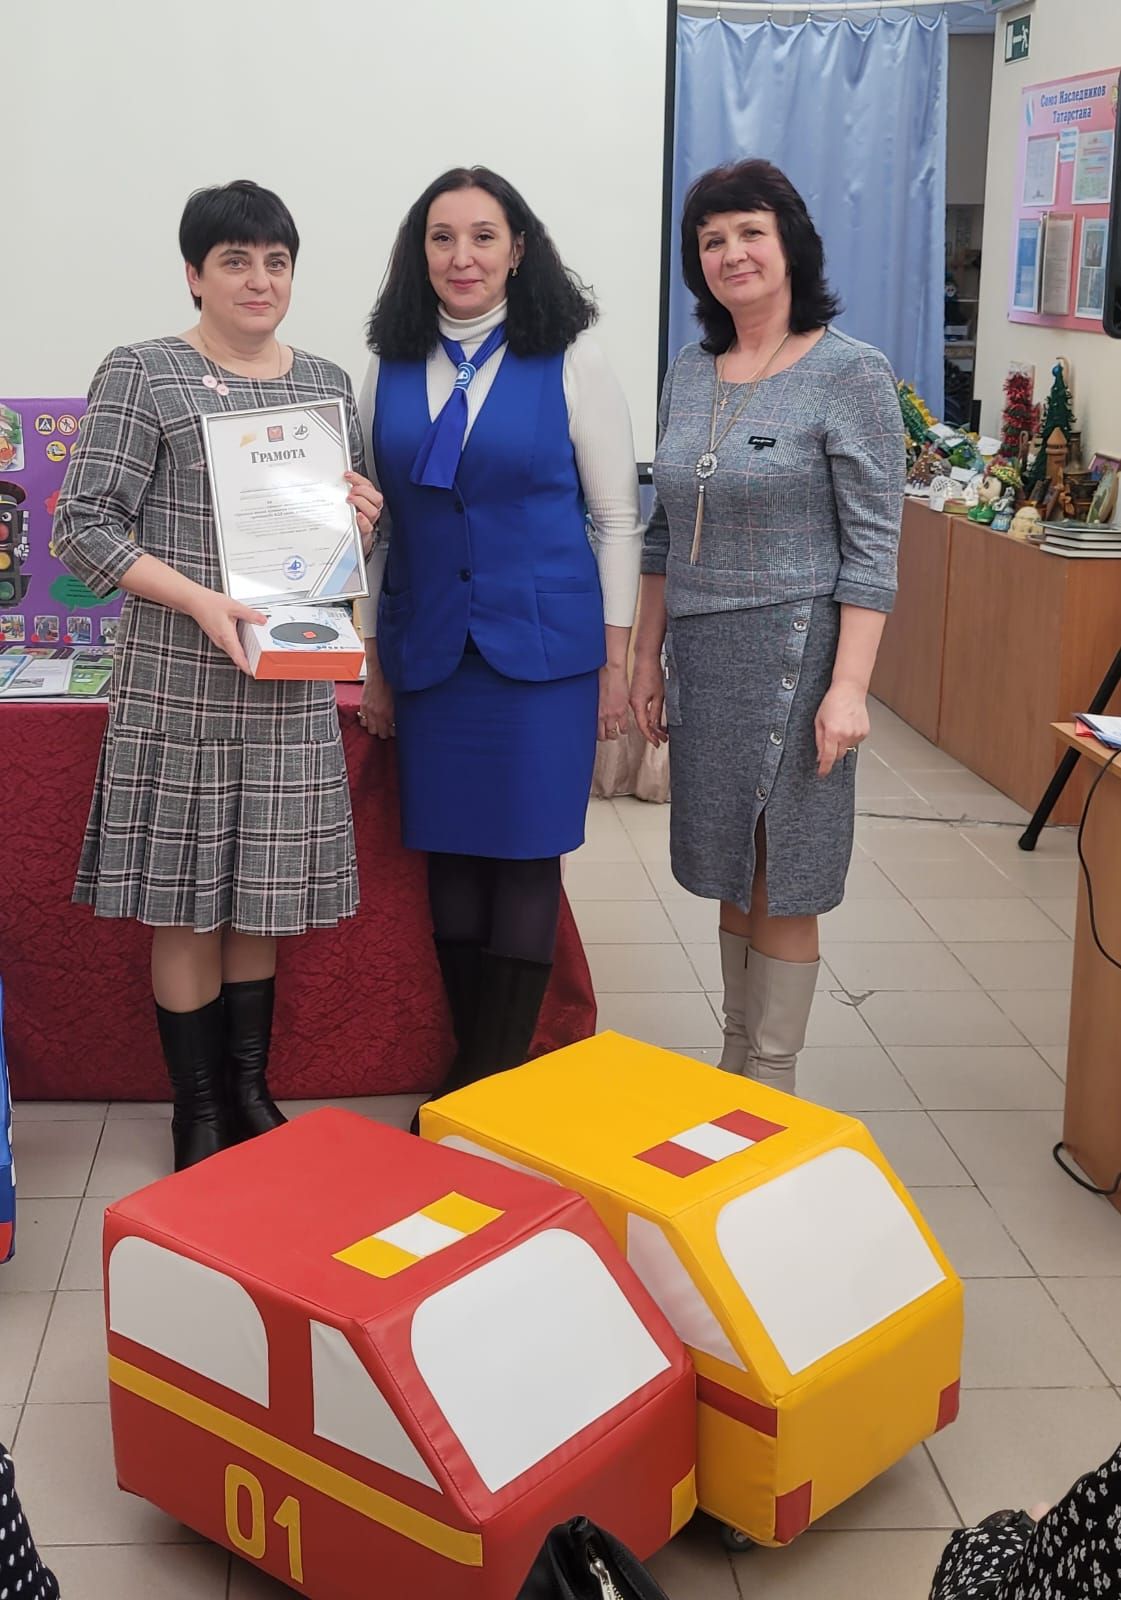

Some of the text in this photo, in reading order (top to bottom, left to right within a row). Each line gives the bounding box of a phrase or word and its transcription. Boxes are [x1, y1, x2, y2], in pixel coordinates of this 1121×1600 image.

[1041, 85, 1106, 107] Союз Наследников
[1053, 107, 1091, 124] Татарстана
[224, 1463, 303, 1585] 01
